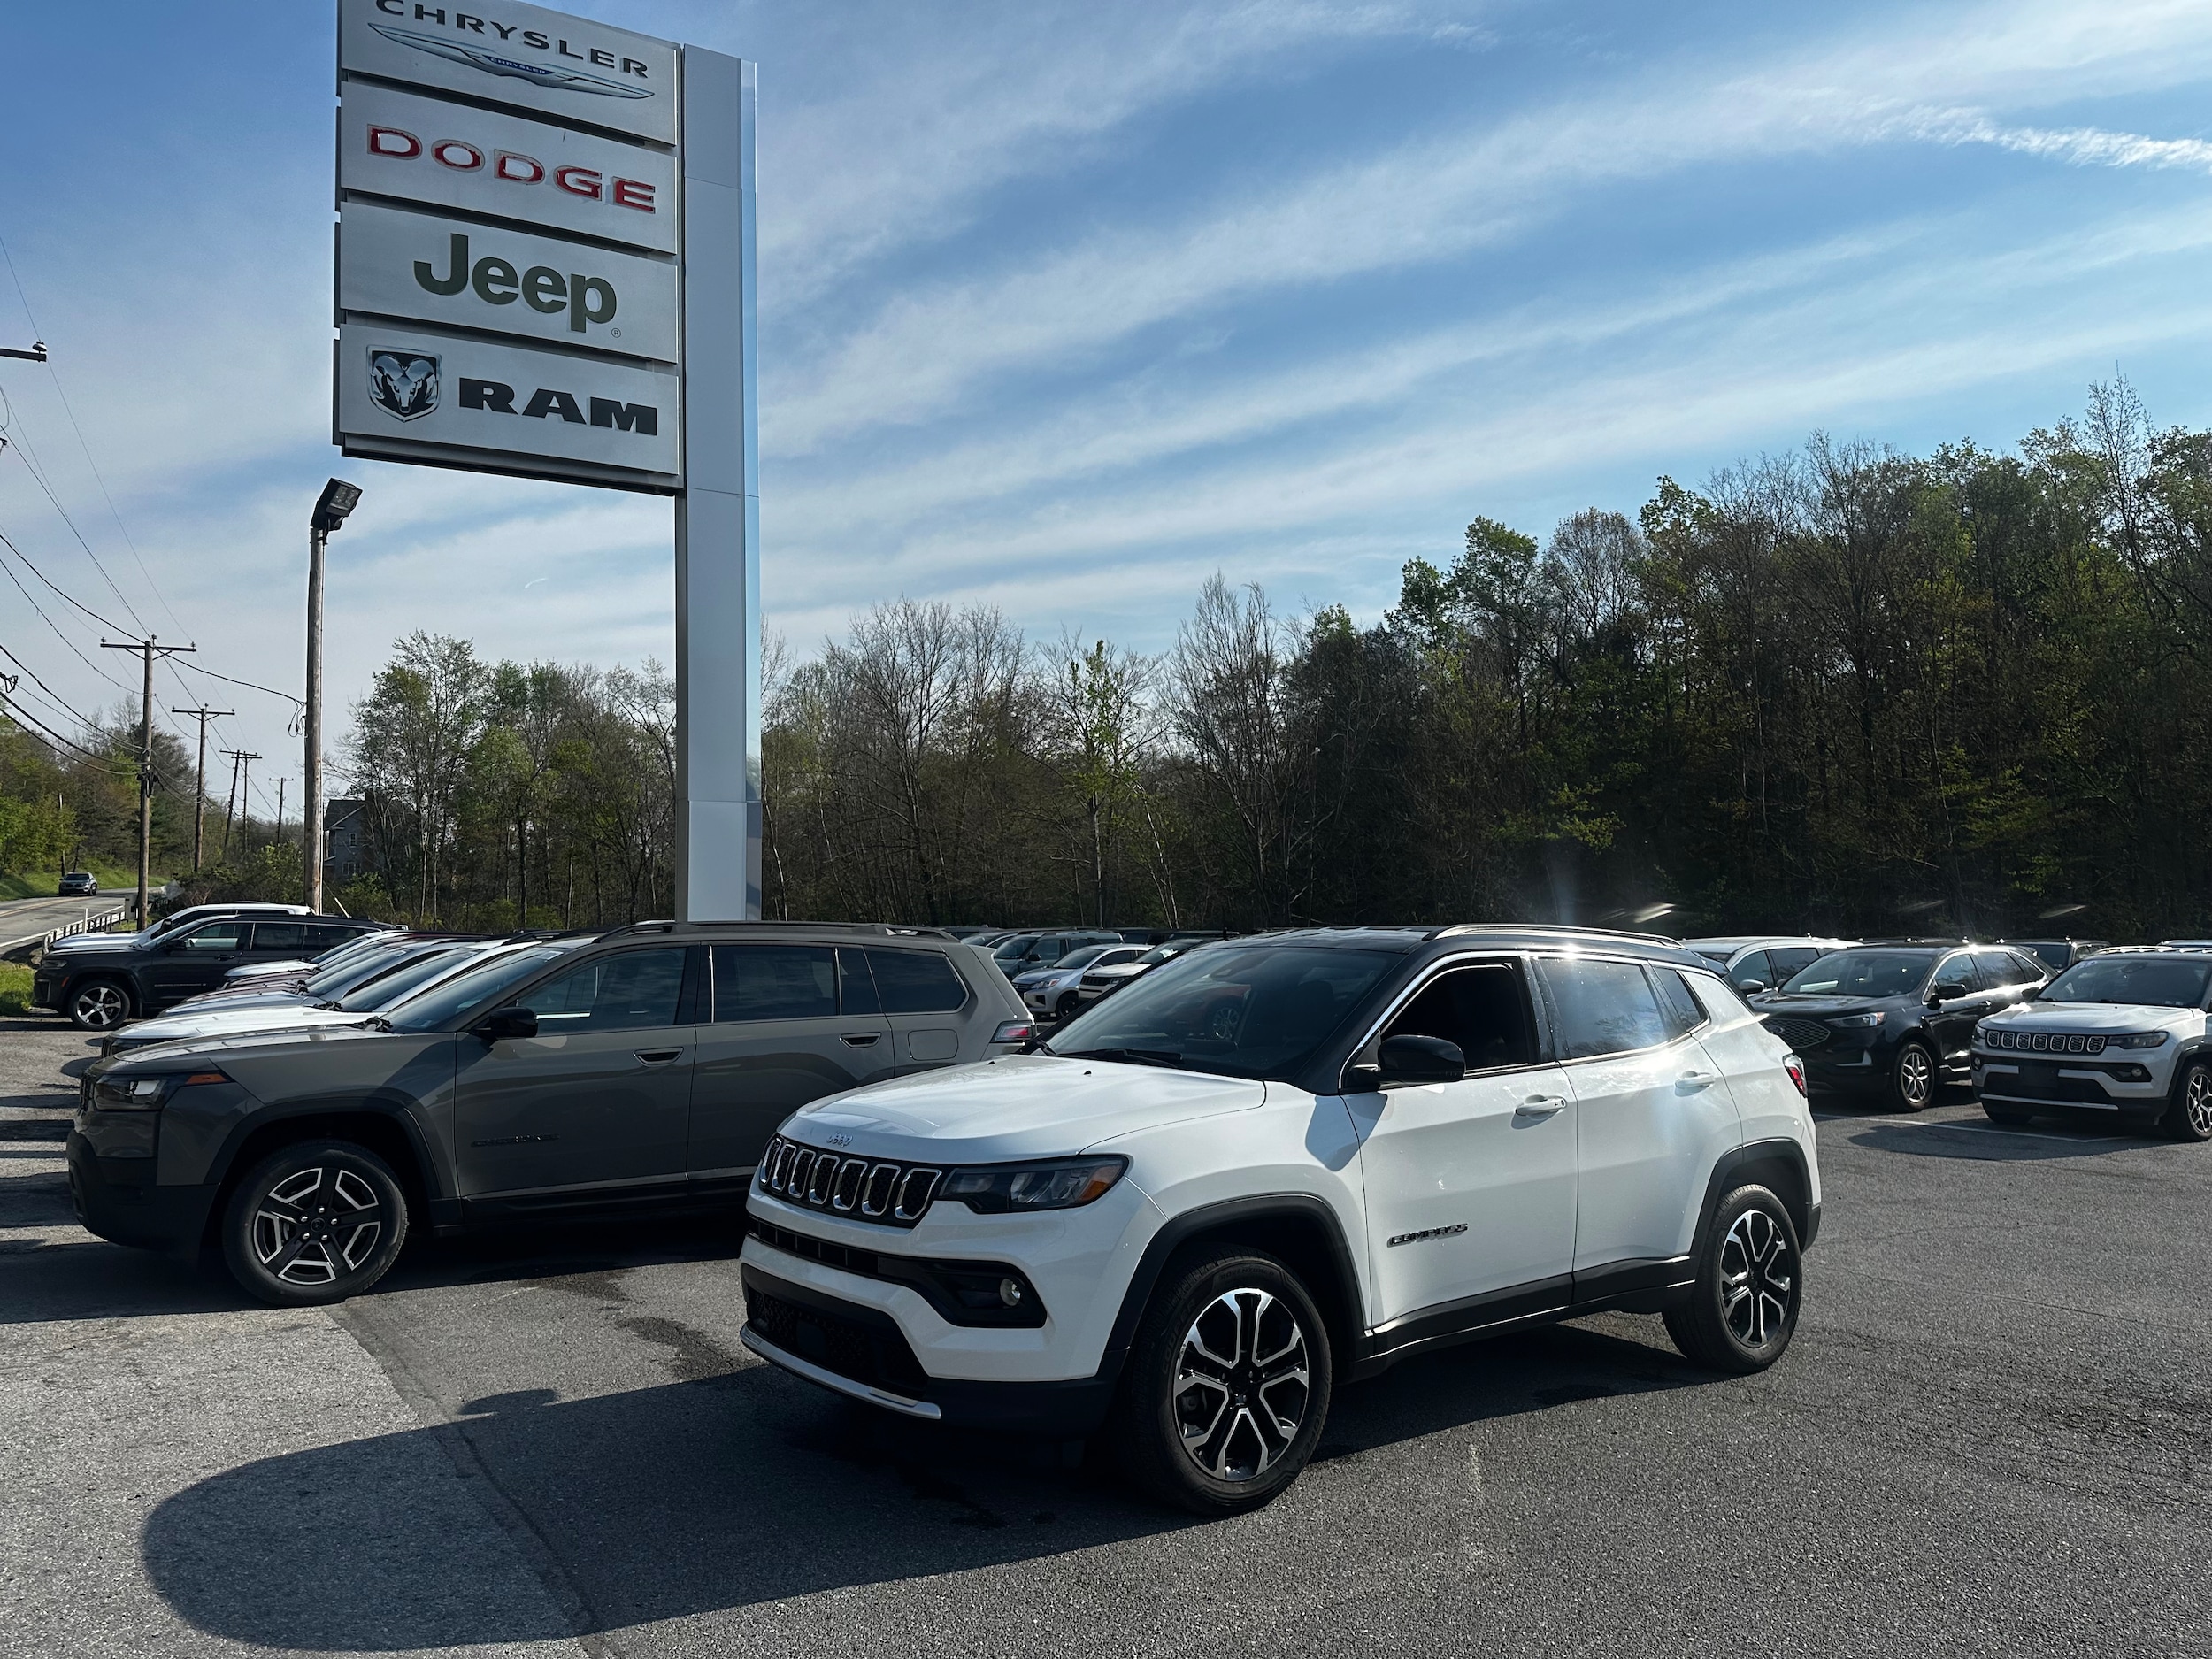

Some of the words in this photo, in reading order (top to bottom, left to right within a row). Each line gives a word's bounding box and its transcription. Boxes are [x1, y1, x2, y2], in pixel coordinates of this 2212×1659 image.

[376, 0, 649, 79] CHRYSLER
[491, 58, 546, 75] CHRYSLER
[366, 124, 656, 214] DODGE
[413, 233, 617, 333] Jeep
[459, 378, 657, 436] RAM
[1388, 1223, 1469, 1246] COMPASS
